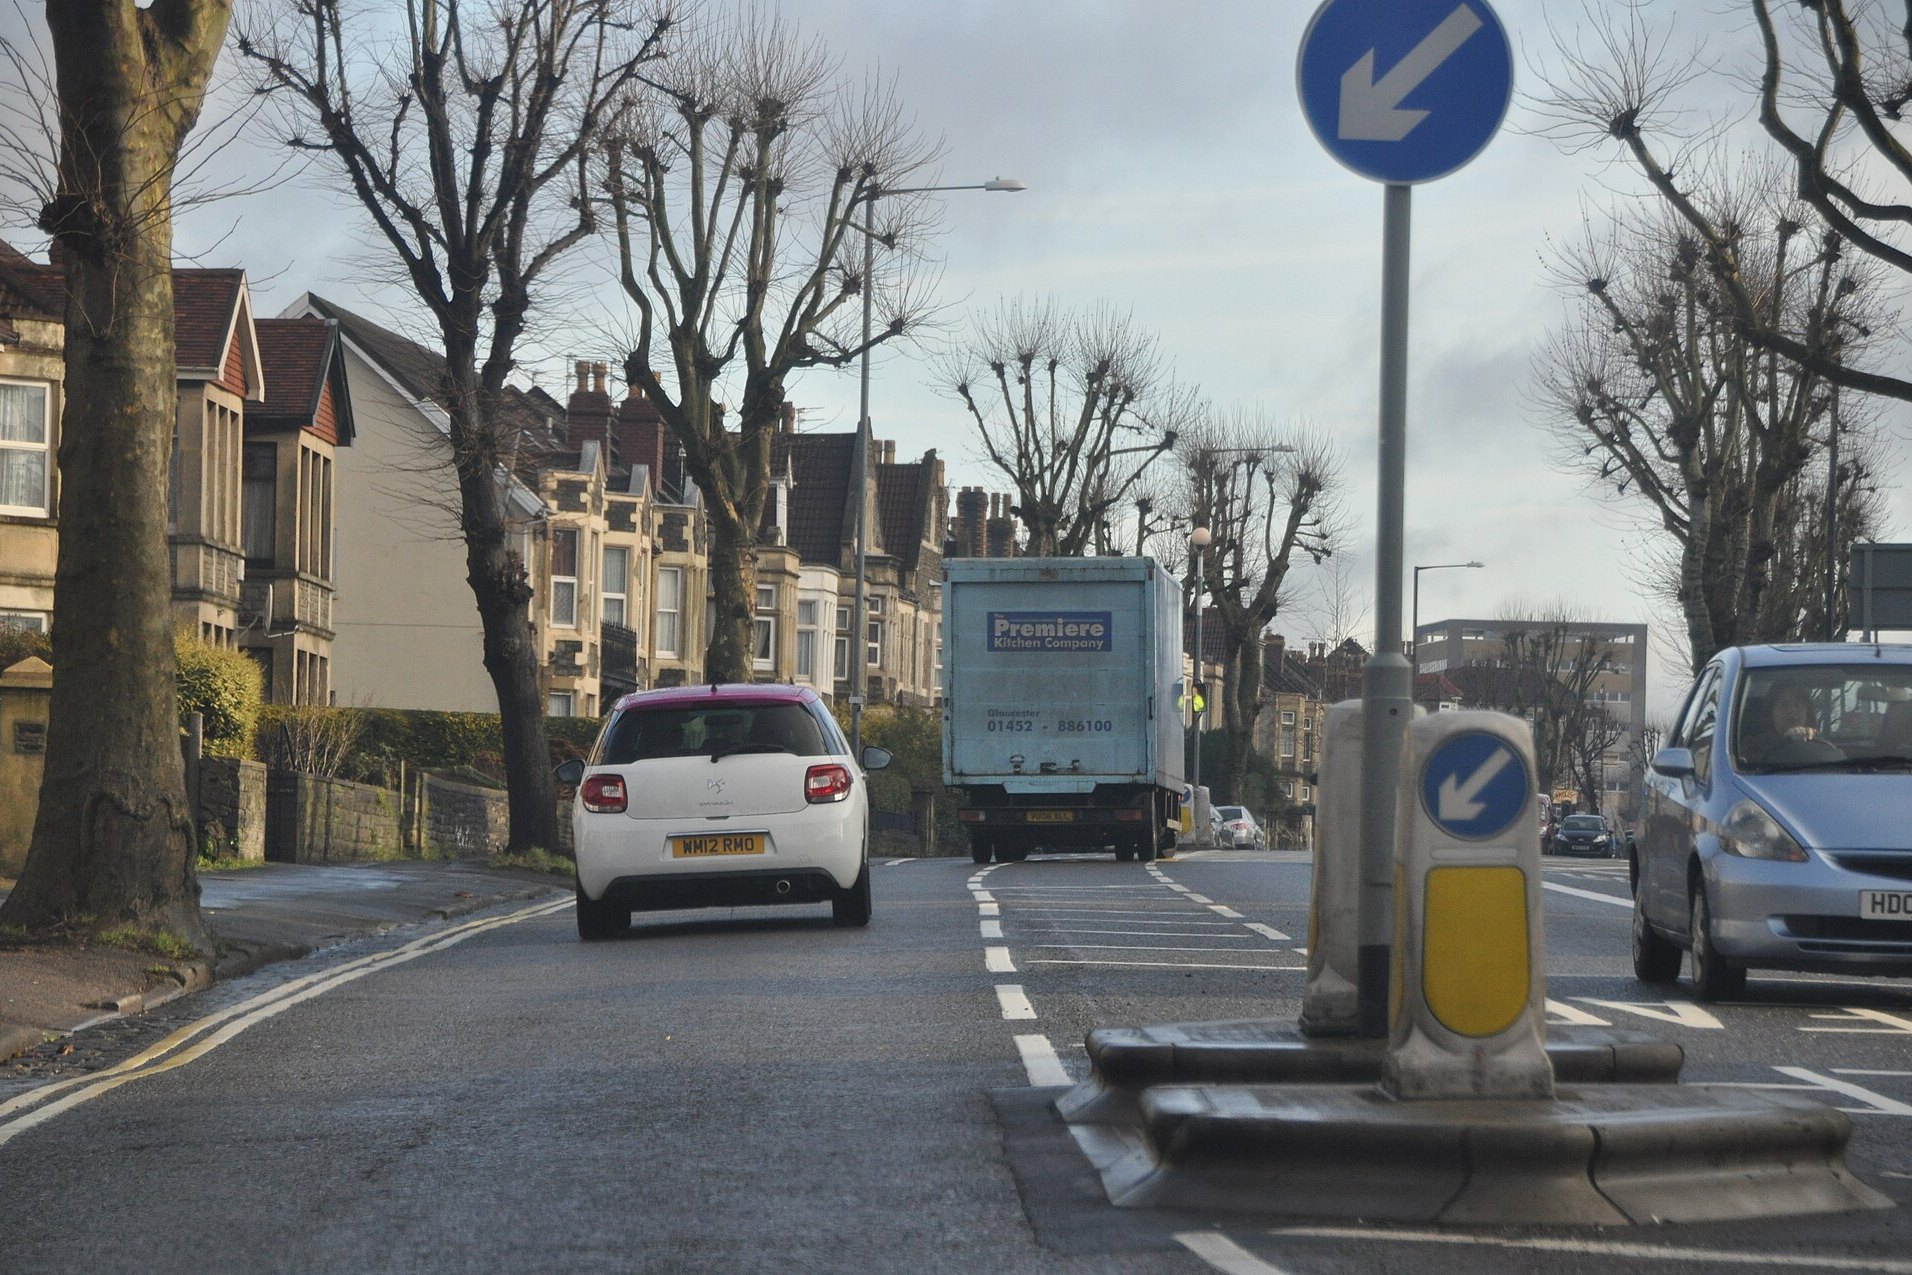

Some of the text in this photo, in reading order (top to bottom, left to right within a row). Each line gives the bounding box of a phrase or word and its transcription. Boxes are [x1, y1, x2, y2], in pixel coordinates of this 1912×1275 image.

[994, 617, 1105, 637] Premiere
[994, 637, 1104, 650] Kitchen Company
[987, 709, 1041, 718] Gloucester
[987, 720, 1033, 732] 01452
[1057, 720, 1112, 732] 886100
[682, 838, 719, 855] WM12
